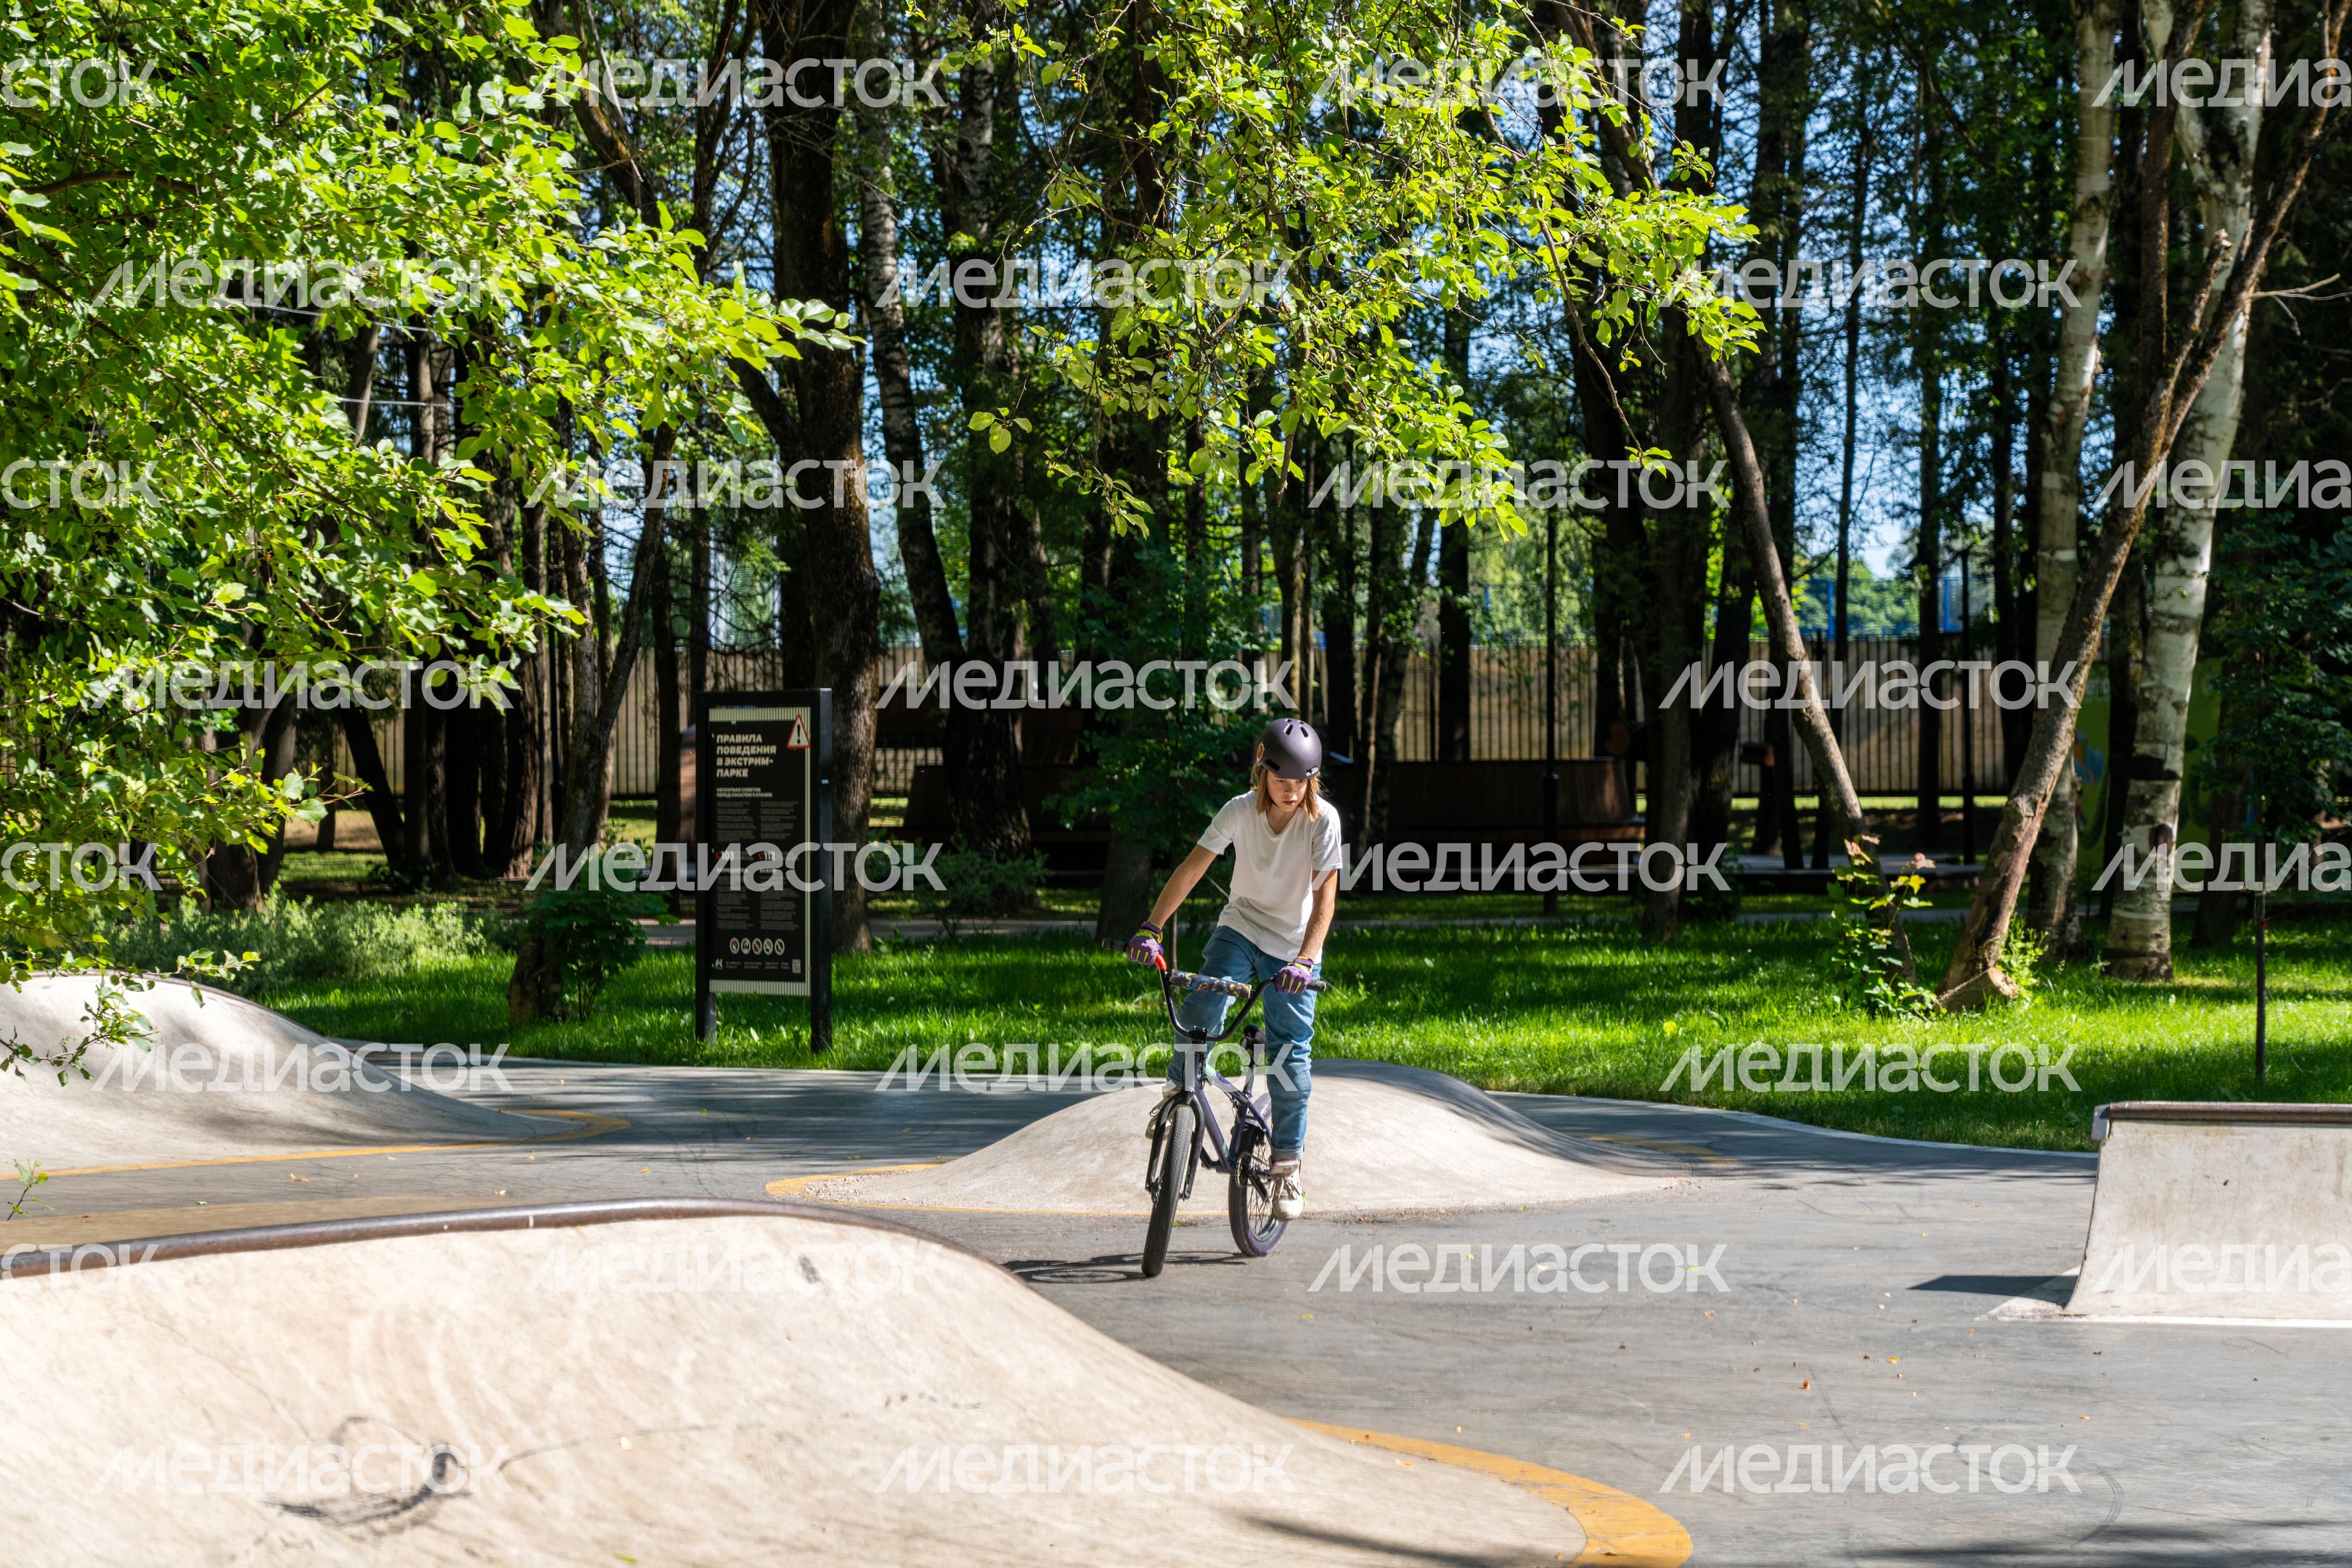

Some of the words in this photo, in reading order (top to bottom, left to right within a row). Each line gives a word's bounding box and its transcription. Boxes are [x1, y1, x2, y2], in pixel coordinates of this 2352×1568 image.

[716, 734, 762, 743] ПРАВИЛА
[716, 746, 777, 756] ПОВЕДЕНИЯ
[716, 757, 723, 766] В
[724, 757, 774, 766] ЭКСТРИМ-
[716, 768, 748, 777] ПАРКЕ
